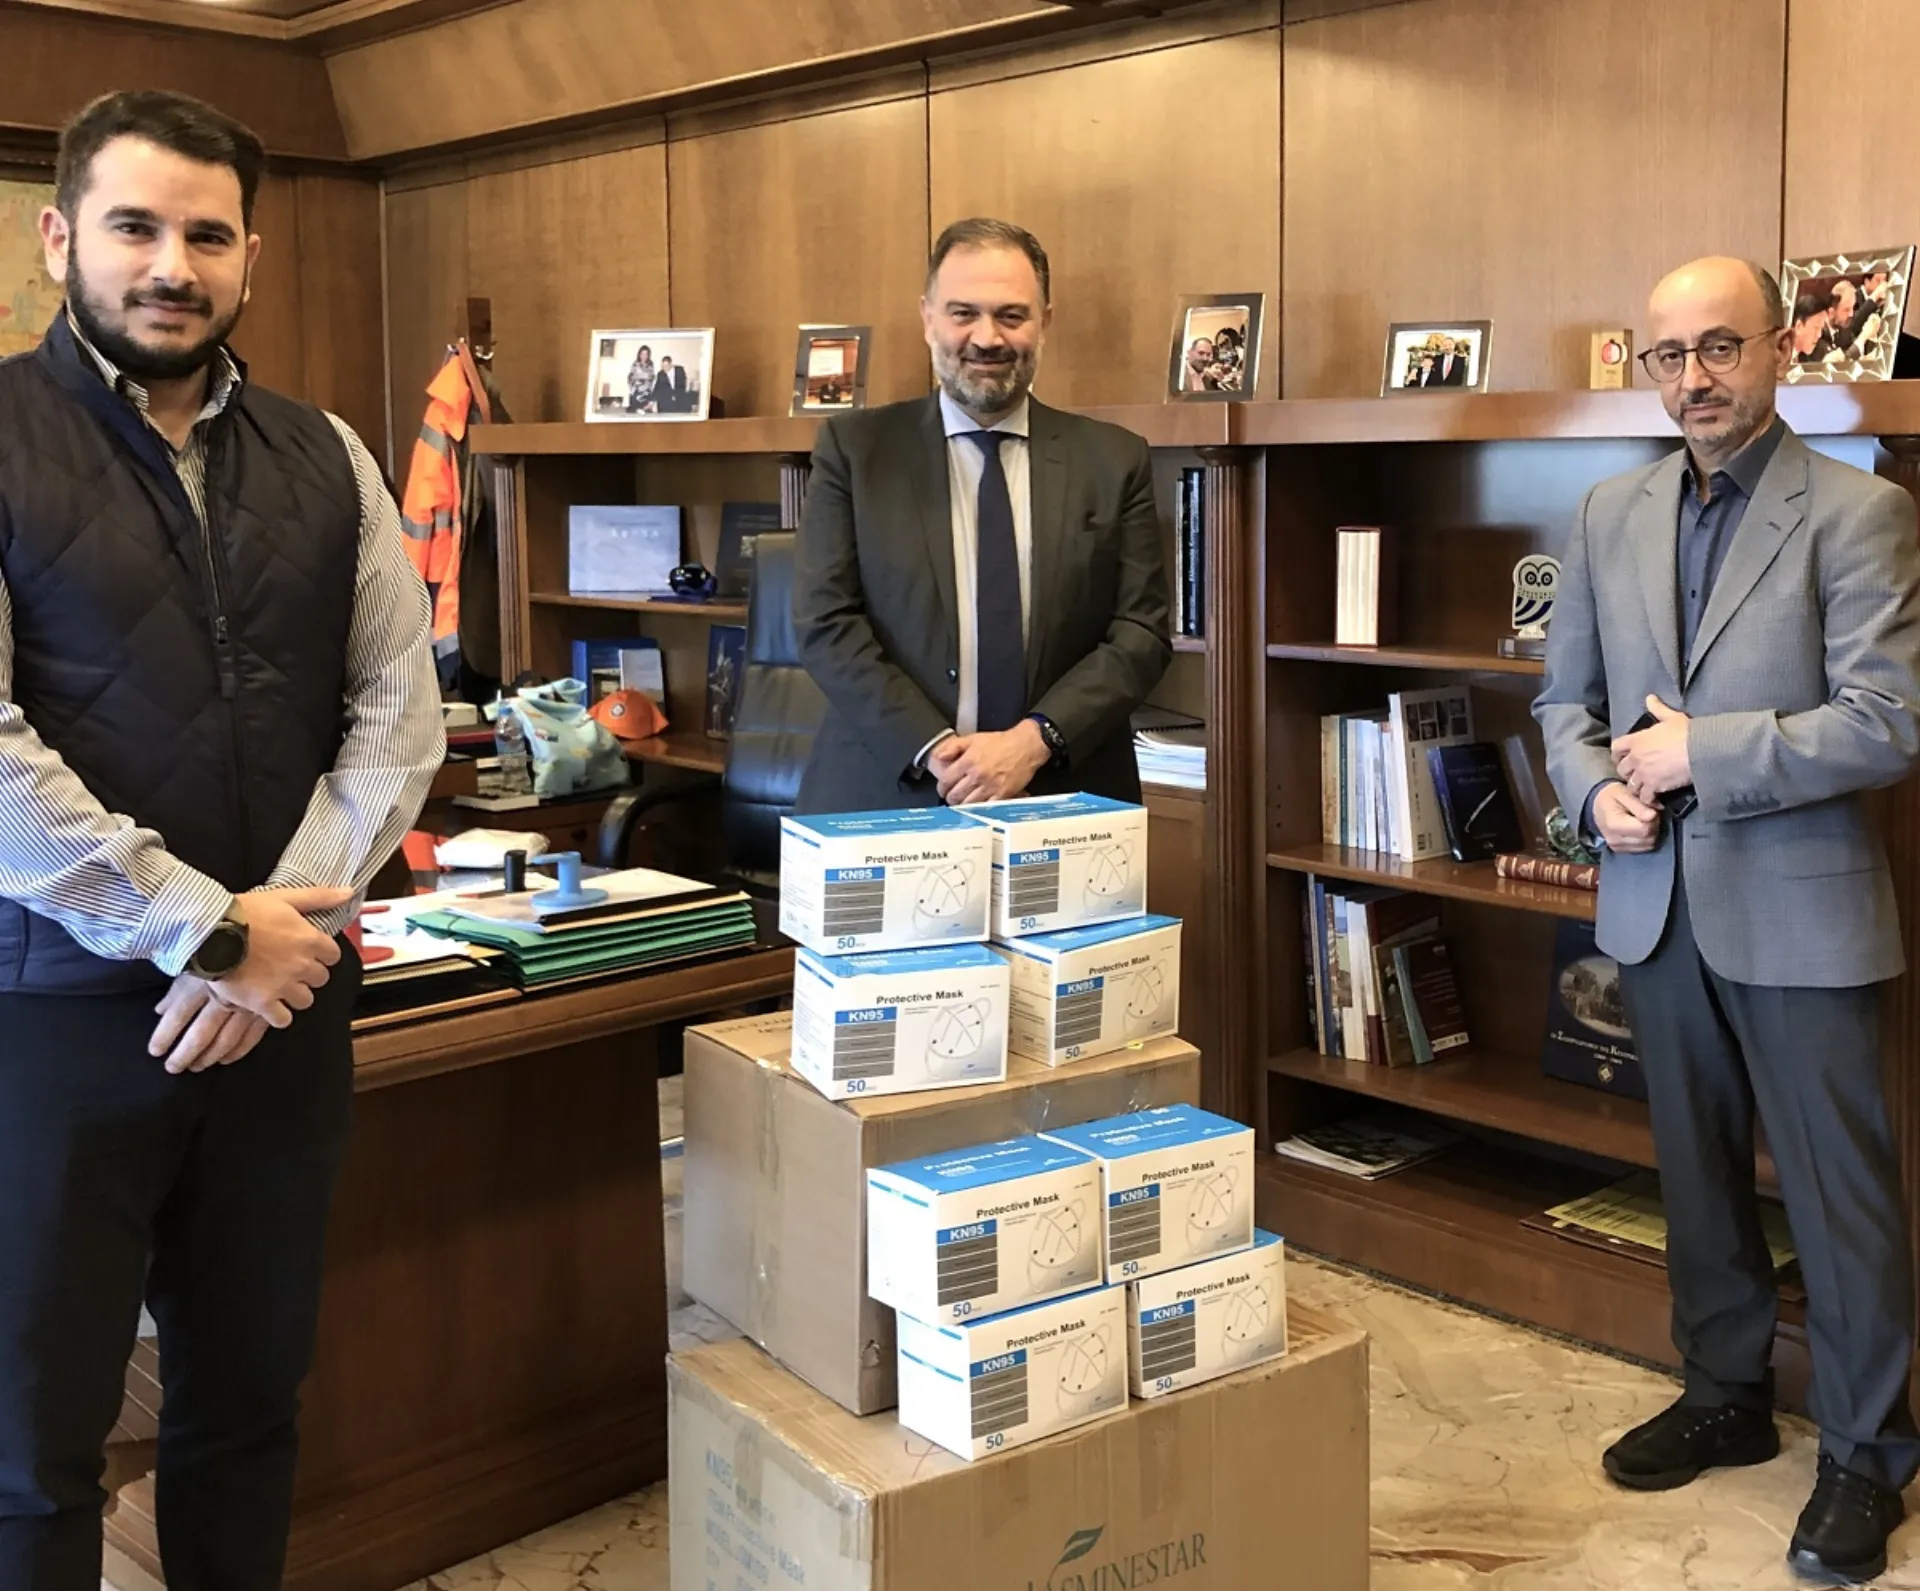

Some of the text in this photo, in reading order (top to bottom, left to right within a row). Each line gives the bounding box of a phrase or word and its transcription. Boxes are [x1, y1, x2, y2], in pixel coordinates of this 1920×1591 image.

[1042, 831, 1113, 847] Protective Mask
[865, 851, 949, 865] Protective Mask
[1020, 851, 1049, 864] KN95
[838, 869, 873, 881] KN95
[1089, 954, 1150, 976] Protective Mask
[1067, 981, 1095, 994] KN95
[876, 989, 964, 1005] Protective Mask
[848, 1009, 884, 1022] KN95
[1142, 1160, 1216, 1183] Protective Mask
[1120, 1187, 1150, 1203] KN95
[976, 1201, 1030, 1219] Protective
[1033, 1192, 1060, 1206] Mask
[950, 1224, 985, 1241] KN95
[1176, 1273, 1251, 1299] Protective Mask
[1153, 1305, 1185, 1321] KN95
[1006, 1319, 1086, 1349] Protective Mask
[982, 1354, 1016, 1373] KN95
